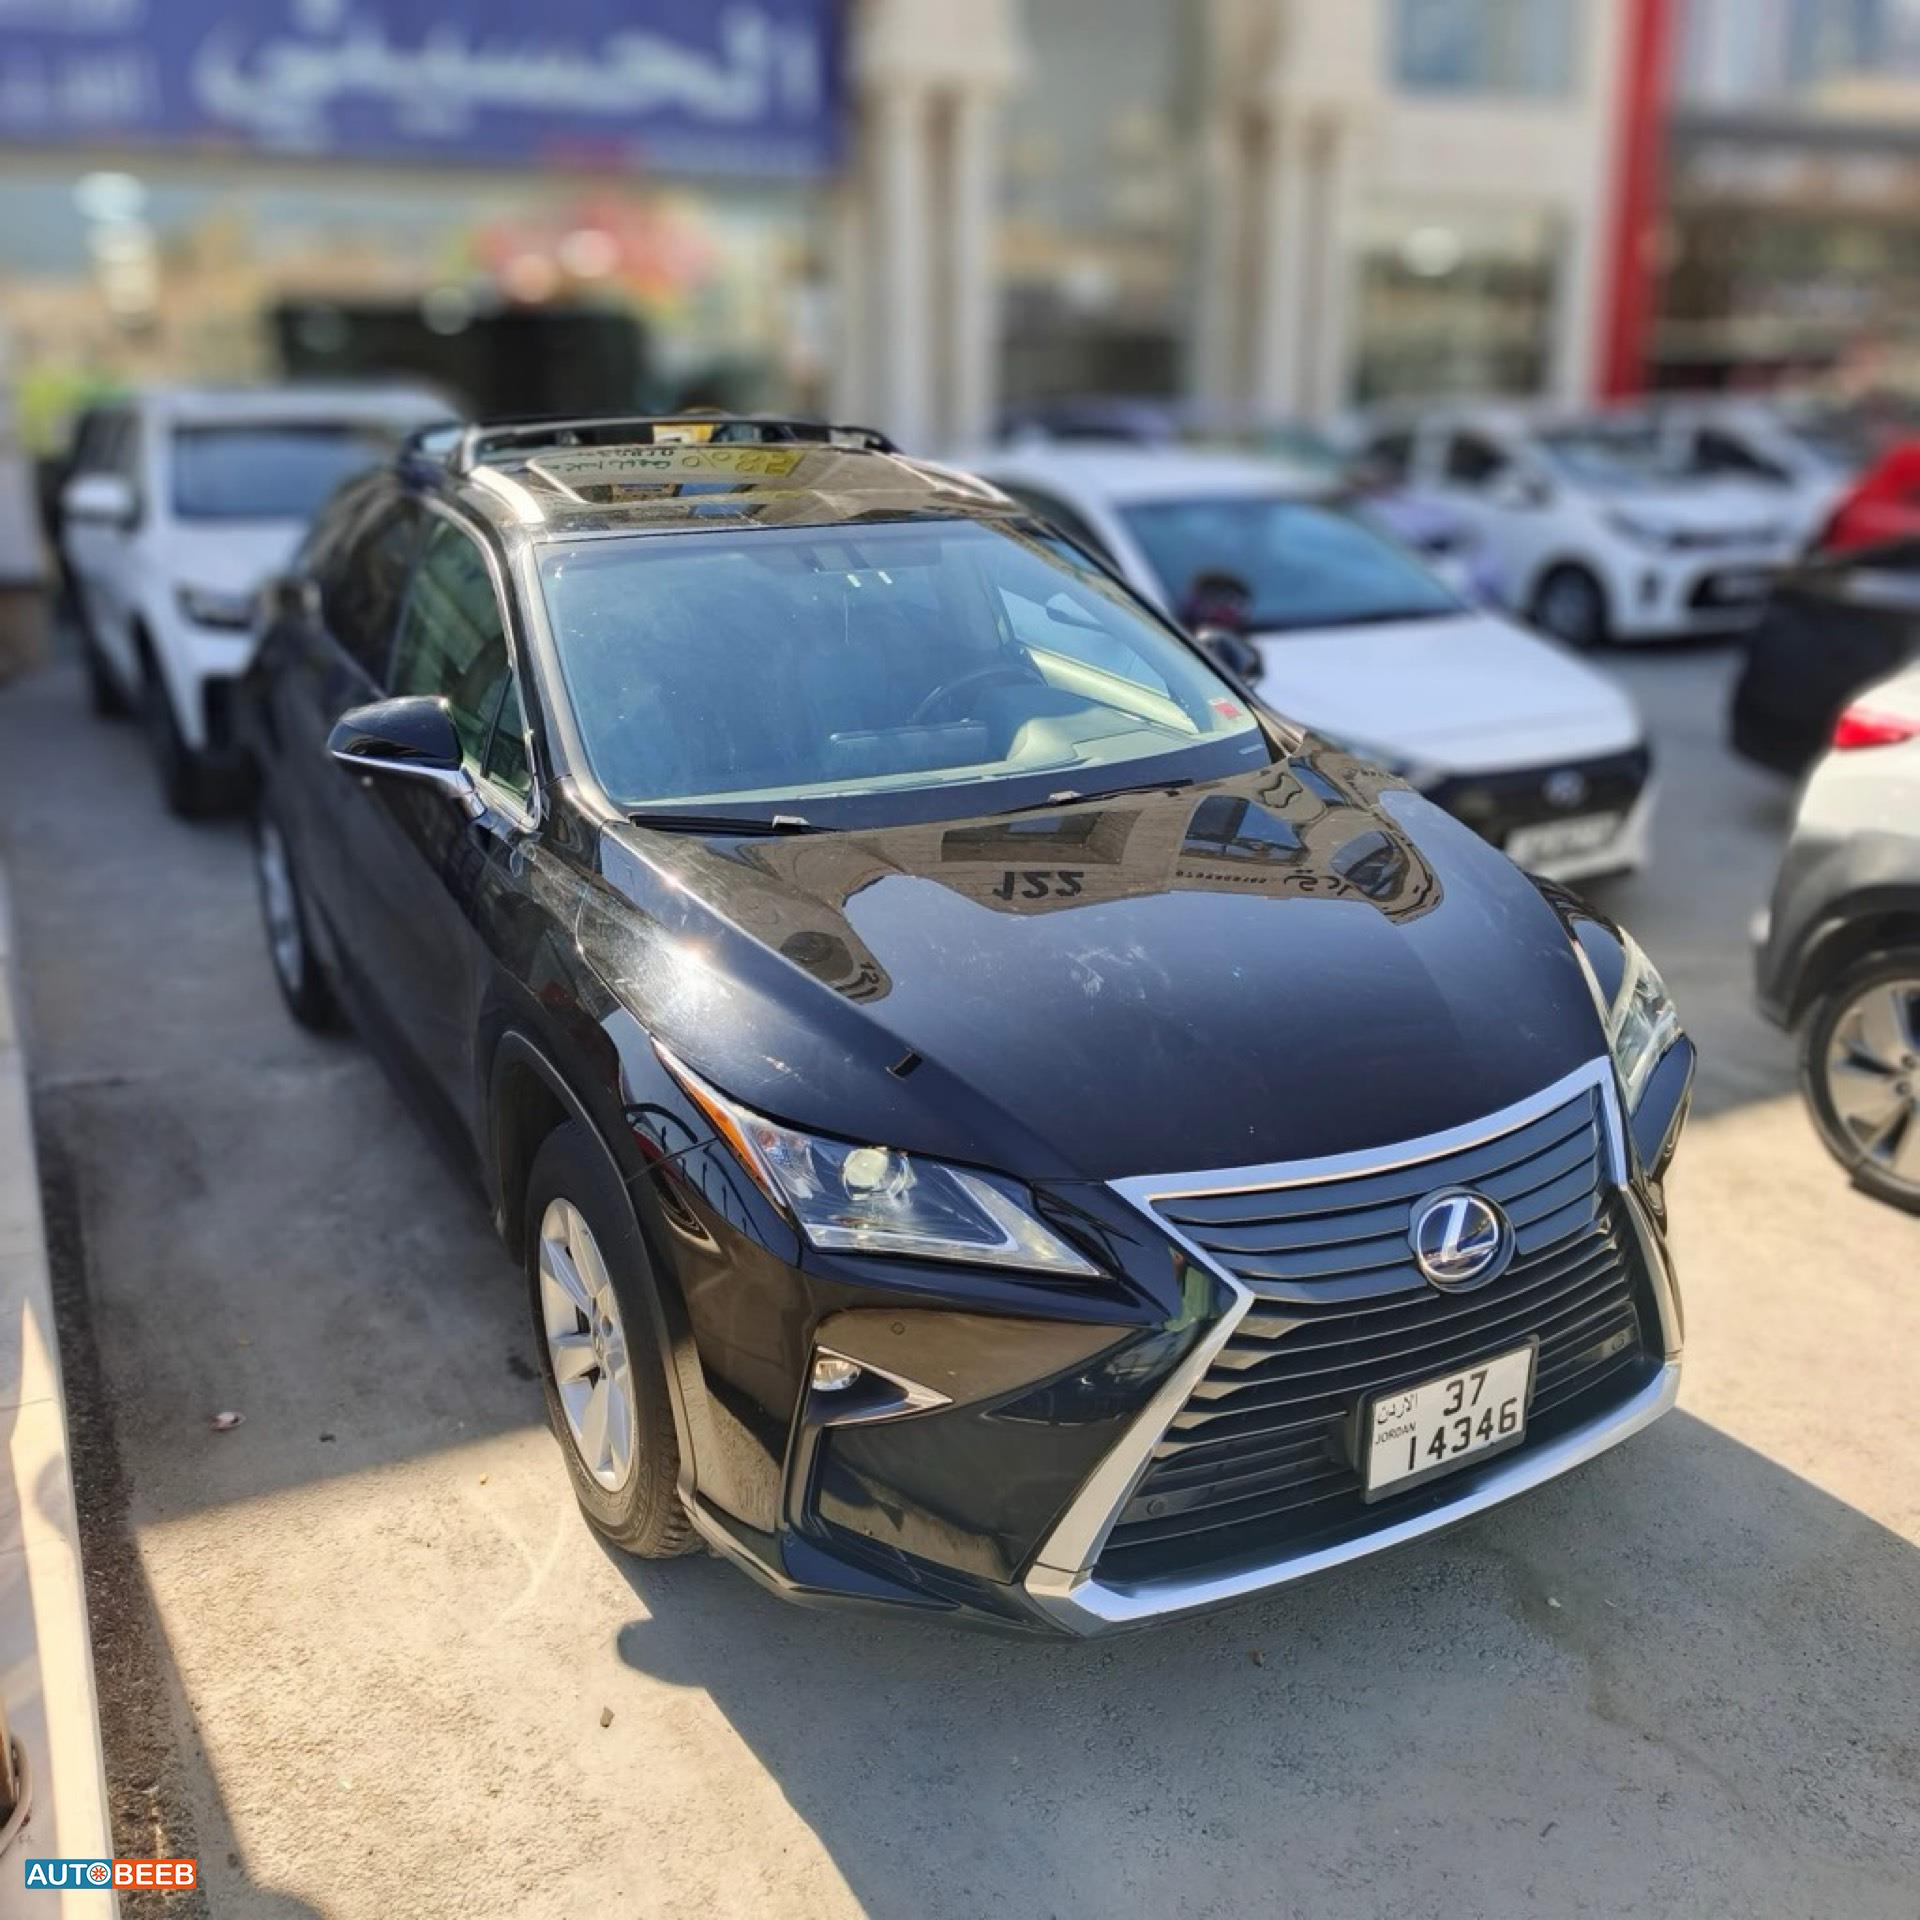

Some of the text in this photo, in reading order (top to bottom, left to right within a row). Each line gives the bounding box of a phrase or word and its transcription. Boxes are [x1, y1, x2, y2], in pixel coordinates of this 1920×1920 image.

[1443, 1369, 1489, 1417] 37
[1375, 1421, 1417, 1444] JORDAN
[1407, 1396, 1518, 1471] 14346
